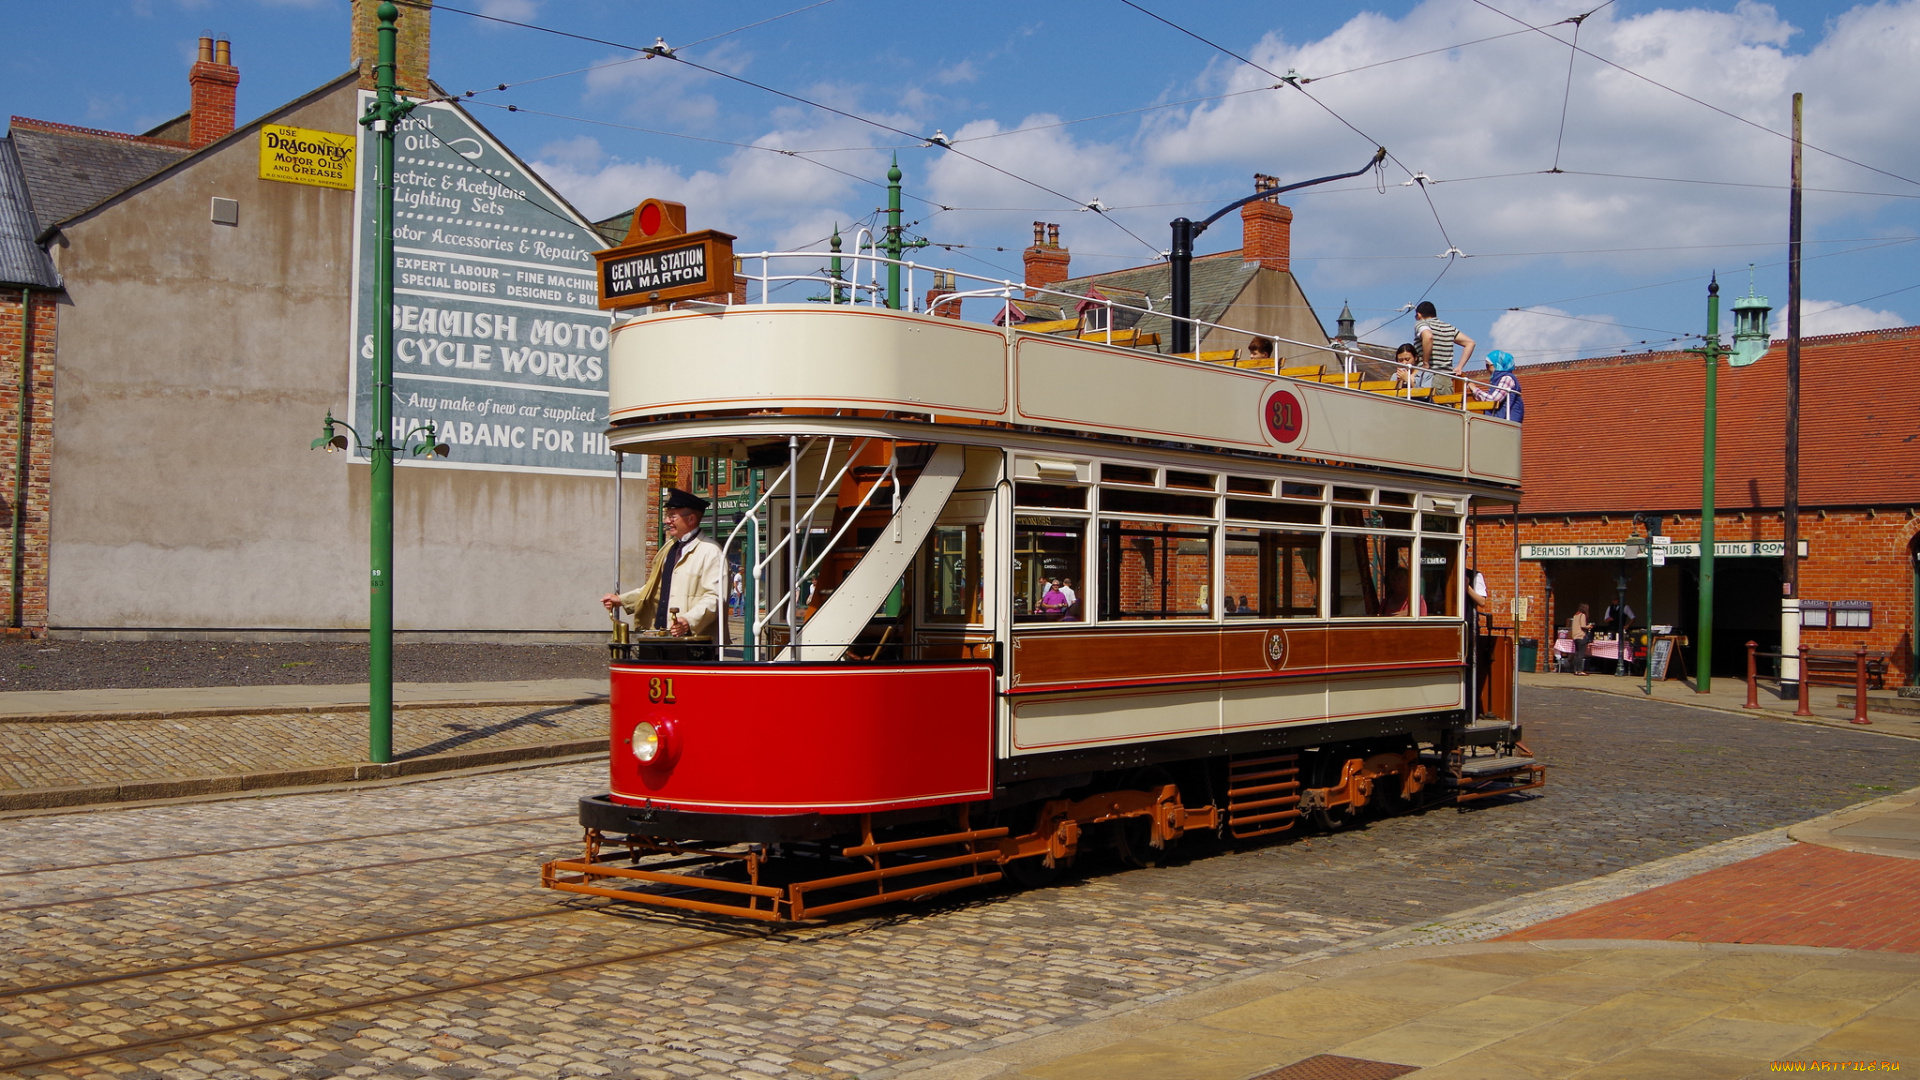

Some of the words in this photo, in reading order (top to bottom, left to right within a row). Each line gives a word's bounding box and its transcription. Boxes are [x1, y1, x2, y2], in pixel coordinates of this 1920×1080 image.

[279, 128, 297, 137] USE
[405, 134, 440, 150] Oils
[274, 153, 313, 166] MOTOR
[318, 158, 343, 170] OILS
[292, 164, 343, 179] GREASES
[394, 186, 461, 214] Lighting
[471, 197, 504, 216] Sets
[441, 175, 454, 190] &
[455, 177, 526, 201] Acetylene
[432, 228, 514, 252] Accessories
[519, 240, 530, 254] &
[396, 257, 446, 272] EXPERT
[450, 264, 499, 279] LABOUR
[516, 271, 544, 284] FINE
[547, 275, 598, 291] MACHINE
[612, 258, 658, 280] CENTRAL
[660, 248, 703, 270] STATION
[402, 273, 451, 288] SPECIAL
[454, 279, 496, 294] BODIES
[506, 285, 562, 300] DESIGNED
[566, 292, 576, 302] &
[580, 294, 598, 306] BUI
[612, 280, 633, 292] VIA
[639, 266, 704, 288] MARTON
[530, 318, 608, 352] MOTO
[397, 338, 492, 371] CYCLE
[500, 346, 604, 382] WORKS
[408, 392, 437, 412] Any
[439, 396, 476, 412] make
[477, 399, 493, 416] of
[492, 403, 516, 415] new
[519, 405, 541, 416] car
[543, 406, 596, 422] supplied
[1272, 401, 1294, 430] 31
[392, 416, 526, 449] HARABANC
[532, 427, 575, 453] FOR
[1530, 545, 1570, 556] BEAMISH
[1577, 546, 1627, 556] TRAMWA
[1644, 545, 1692, 555] ONIBUS
[649, 676, 676, 704] 31
